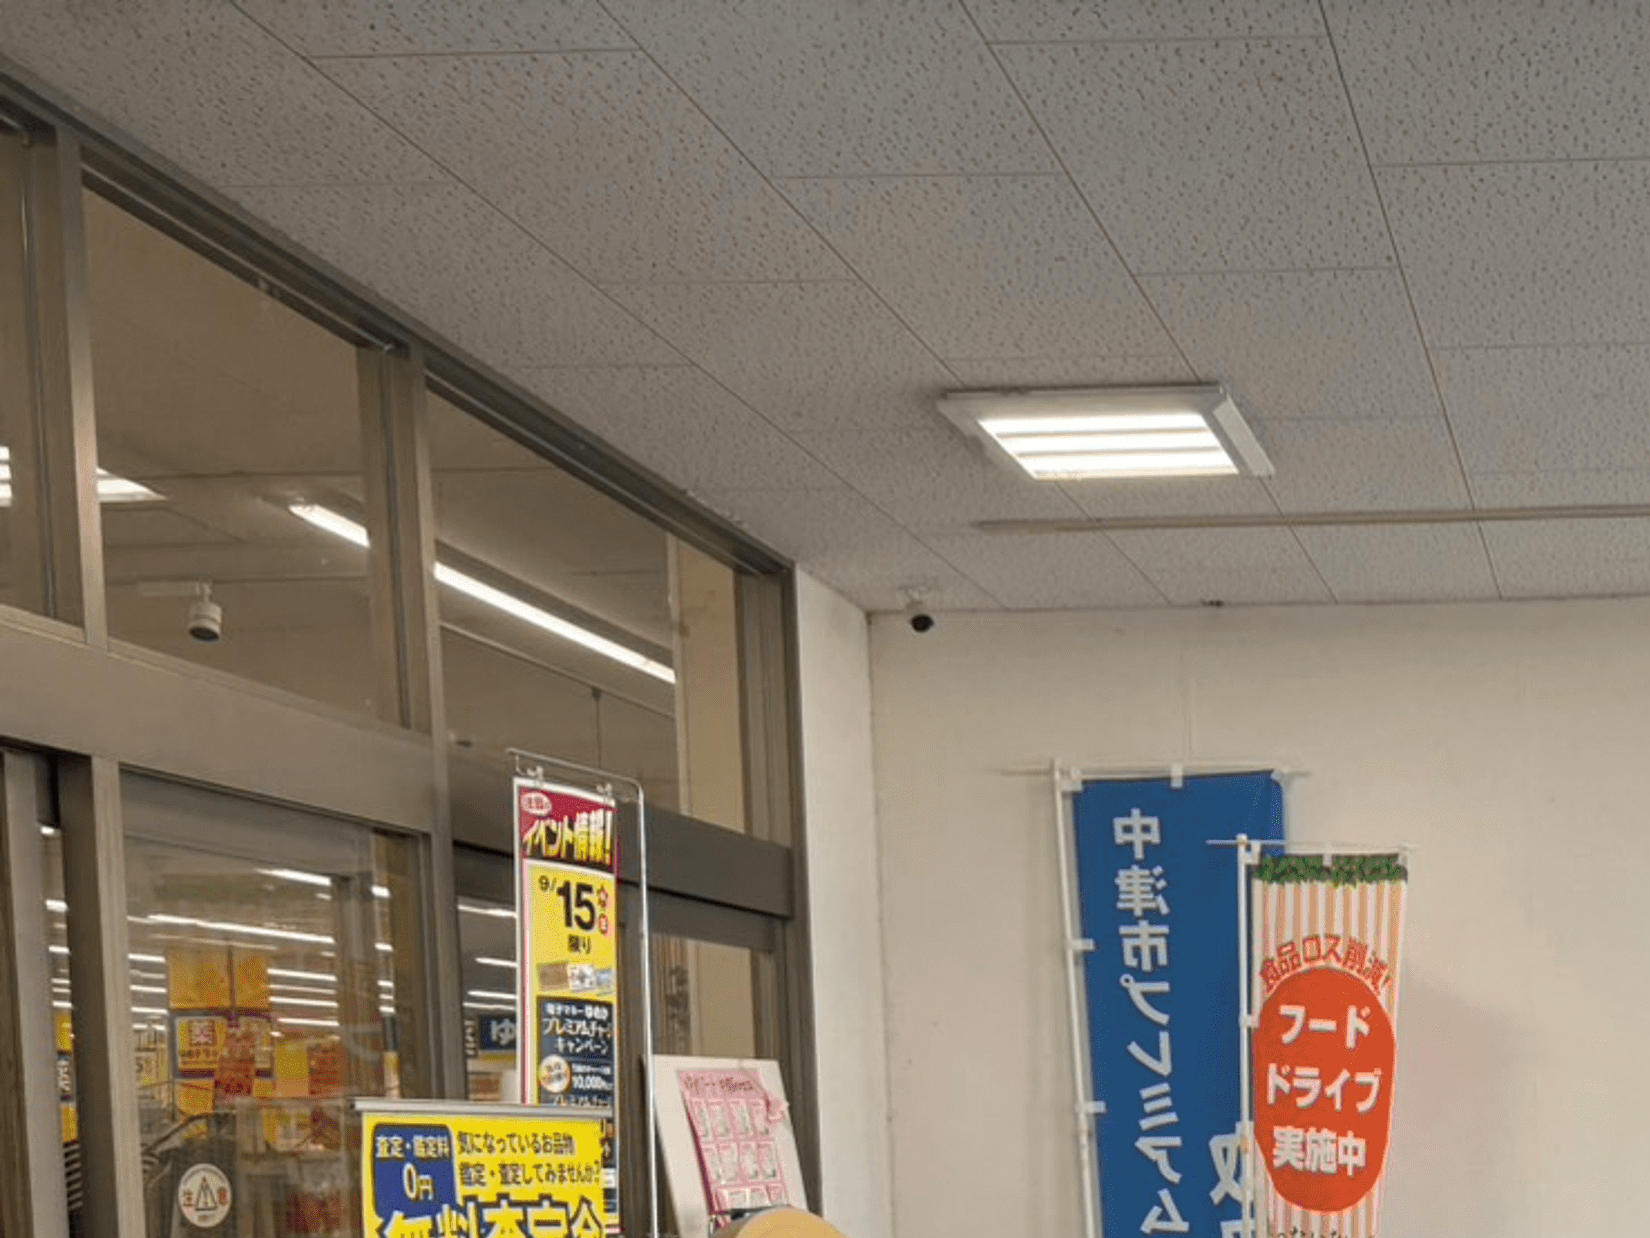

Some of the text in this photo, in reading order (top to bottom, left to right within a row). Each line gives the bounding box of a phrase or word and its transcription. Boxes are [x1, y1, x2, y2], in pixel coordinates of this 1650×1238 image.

[1279, 1003, 1372, 1050] フード
[1266, 1062, 1383, 1113] ドライブ
[1272, 1124, 1367, 1177] 実施中
[403, 1161, 434, 1200] 0円
